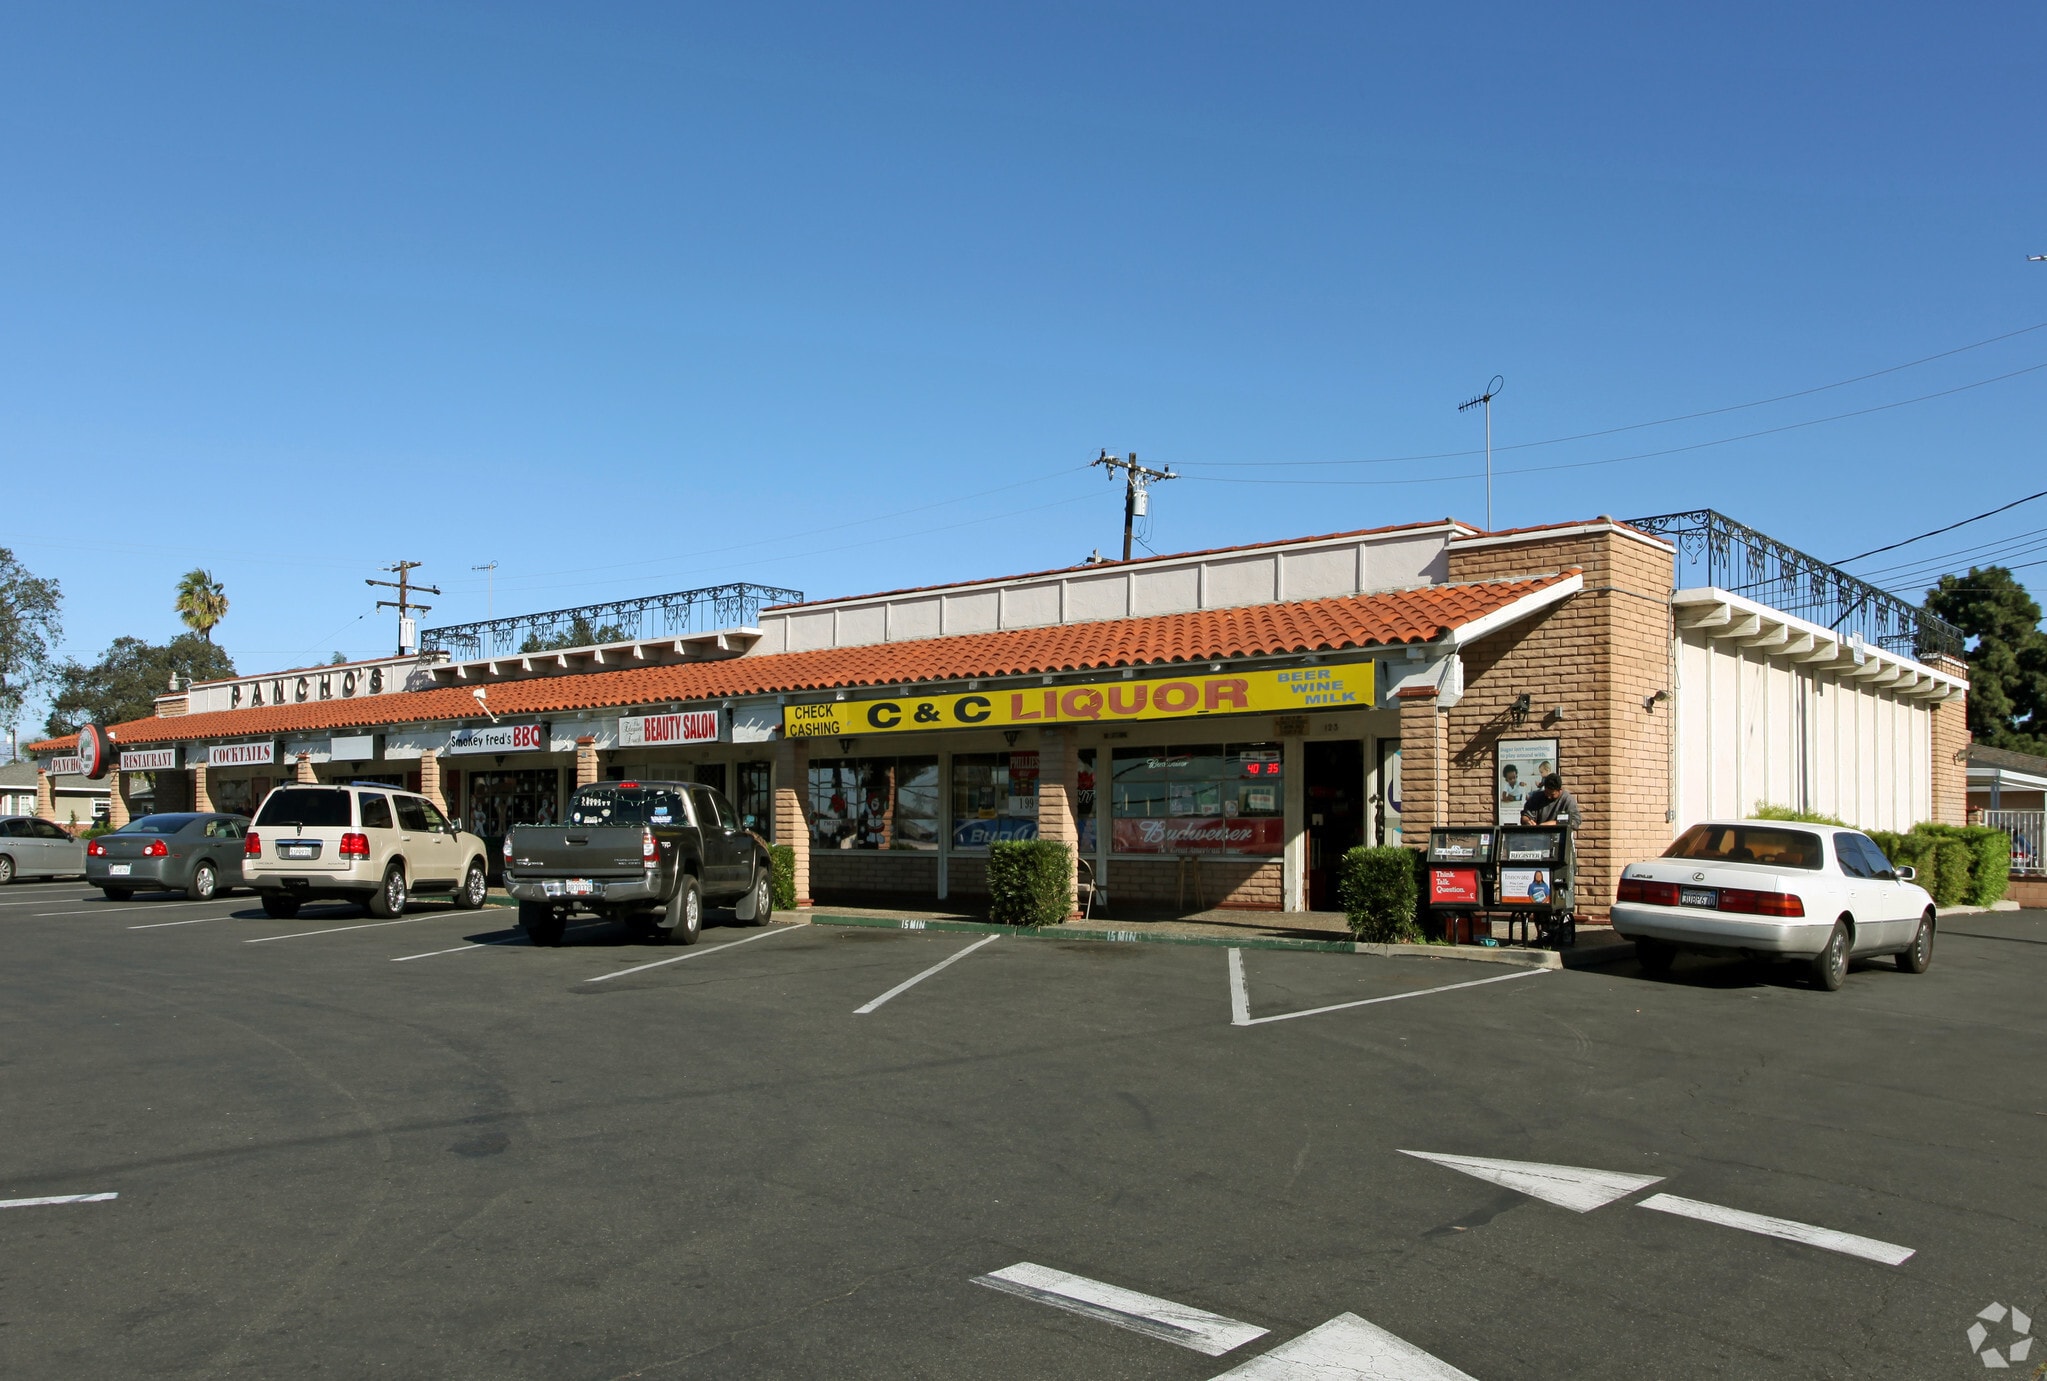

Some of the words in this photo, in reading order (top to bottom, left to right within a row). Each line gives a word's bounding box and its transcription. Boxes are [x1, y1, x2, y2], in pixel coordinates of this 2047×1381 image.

[1277, 669, 1331, 683] BEER
[1290, 680, 1344, 693] WINE
[867, 702, 902, 729] C
[914, 702, 942, 723] &
[954, 695, 992, 723] C
[1011, 678, 1250, 720] LIQUOR
[1305, 691, 1356, 705] MILK
[795, 703, 834, 720] CHECK
[644, 715, 681, 742] BEAUTY
[683, 712, 716, 740] SALON
[790, 720, 840, 737] CASHING
[1324, 723, 1339, 732] 123
[486, 732, 511, 746] Fred's
[513, 724, 541, 747] BBQ
[123, 751, 174, 769] RESTAURANT
[213, 743, 271, 764] COCKTAILS
[1010, 755, 1040, 770] PHILLIES
[1247, 763, 1261, 774] 40
[1267, 763, 1279, 774] 35
[1139, 820, 1253, 844] Budweiser
[1436, 886, 1465, 894] Question.
[910, 919, 926, 930] MIN
[1117, 931, 1137, 942] MIN
